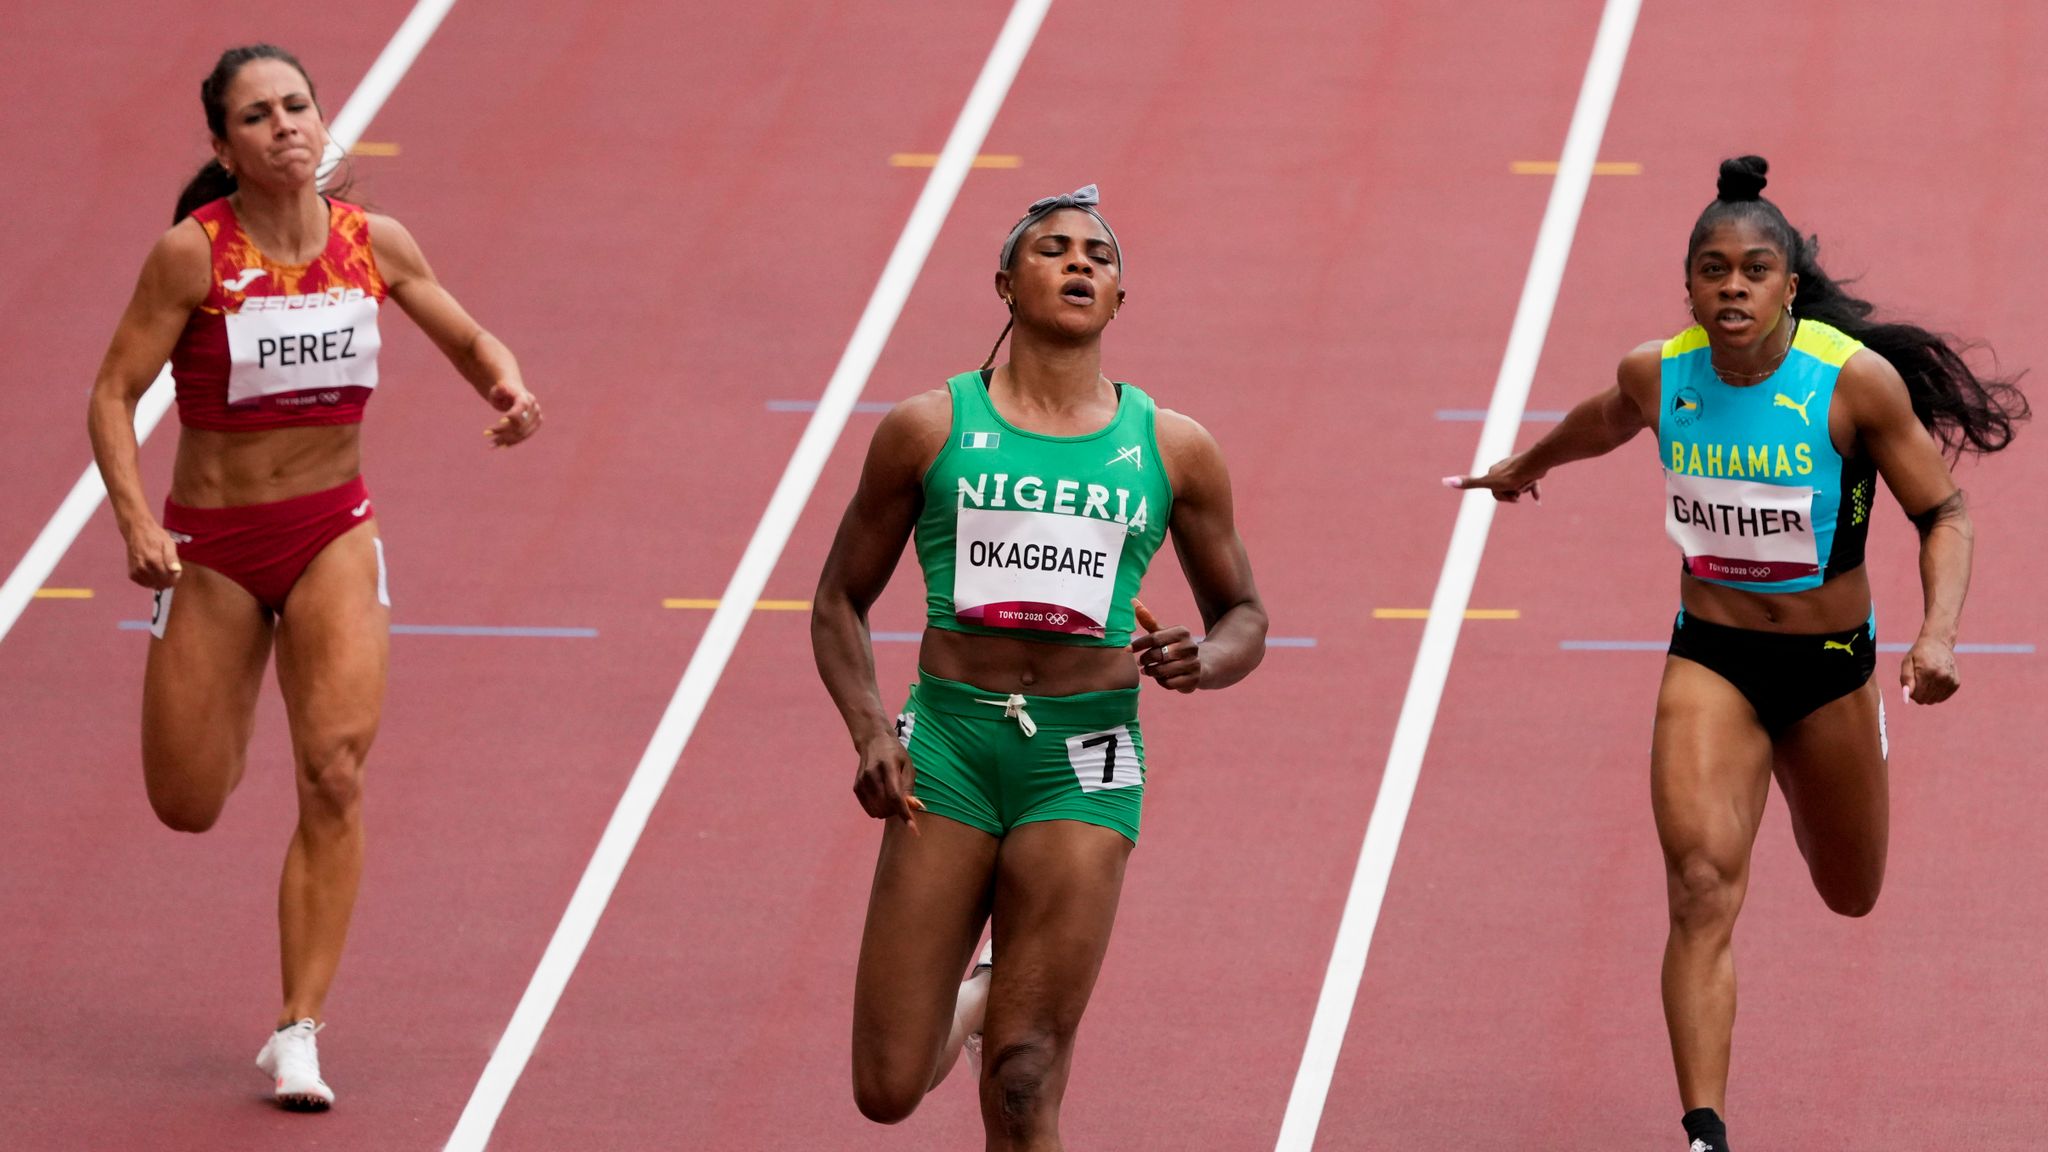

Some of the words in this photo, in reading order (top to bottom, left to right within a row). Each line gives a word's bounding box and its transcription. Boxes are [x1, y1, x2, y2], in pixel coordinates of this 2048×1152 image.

[257, 327, 357, 370] PEREZ
[1671, 441, 1813, 478] BAHAMAS
[957, 473, 1148, 533] NIGERIA
[1672, 495, 1805, 537] GAITHER
[969, 540, 1107, 579] OKAGBARE
[1730, 566, 1747, 576] 2020
[999, 610, 1023, 620] TOKYO
[1024, 612, 1043, 622] 2020
[1082, 734, 1118, 783] 7
